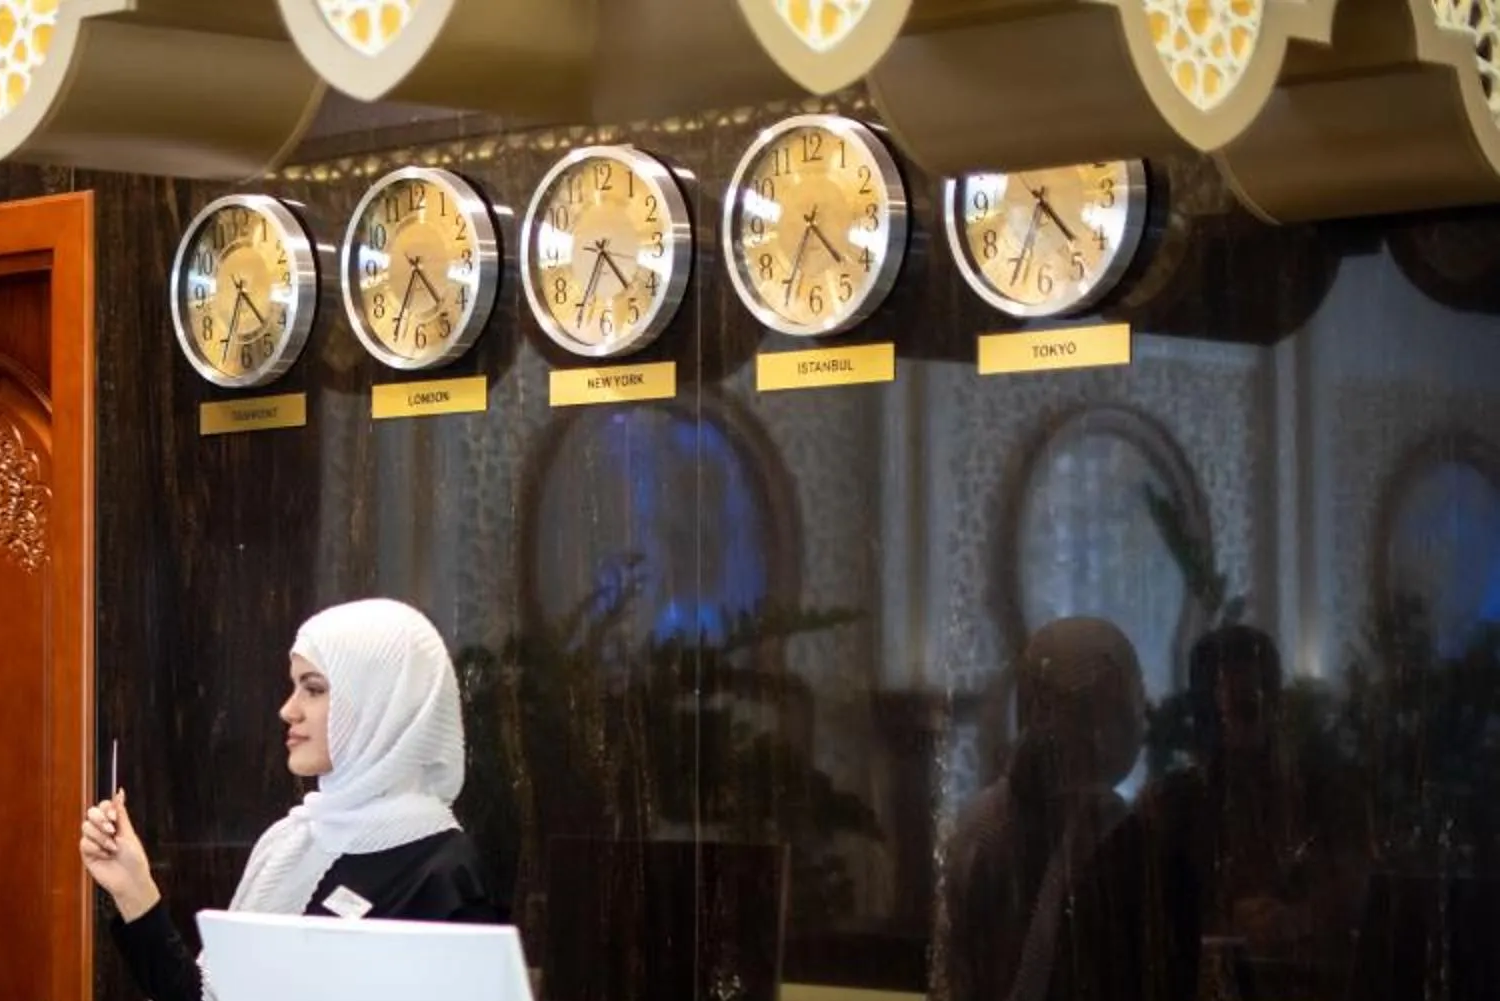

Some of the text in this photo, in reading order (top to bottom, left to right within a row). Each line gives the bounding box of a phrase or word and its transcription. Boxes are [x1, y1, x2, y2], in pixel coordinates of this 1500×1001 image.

[801, 132, 823, 163] 12
[839, 140, 846, 169] 1
[772, 147, 791, 177] 11
[594, 163, 613, 191] 12
[626, 170, 634, 199] 1
[753, 176, 775, 206] 10
[858, 164, 872, 195] 2
[409, 184, 426, 212] 12
[439, 191, 447, 217] 1
[973, 191, 989, 222] 9
[1099, 178, 1116, 210] 3
[384, 198, 400, 224] 11
[549, 205, 569, 233] 10
[645, 195, 658, 223] 2
[865, 203, 879, 233] 3
[261, 217, 268, 242] 1
[455, 214, 467, 241] 2
[750, 215, 765, 245] 9
[1090, 224, 1106, 252] 4
[650, 231, 664, 259] 3
[982, 229, 998, 260] 8
[365, 259, 377, 283] 9
[461, 248, 473, 274] 3
[759, 252, 774, 281] 8
[859, 246, 873, 274] 4
[1007, 257, 1024, 288] 7
[1068, 251, 1085, 283] 5
[555, 276, 568, 305] 8
[645, 269, 658, 298] 4
[781, 279, 792, 308] 7
[837, 273, 853, 304] 5
[1036, 264, 1053, 296] 6
[194, 284, 205, 309] 9
[373, 294, 385, 319] 8
[456, 286, 468, 312] 4
[808, 284, 824, 316] 6
[439, 312, 451, 338] 5
[575, 302, 586, 329] 7
[599, 310, 613, 338] 6
[627, 297, 640, 325] 5
[202, 315, 213, 341] 8
[392, 316, 404, 343] 7
[414, 323, 427, 350] 6
[241, 343, 252, 369] 6
[263, 334, 274, 358] 5
[1031, 341, 1077, 359] TOKYO
[797, 358, 855, 375] ISTANBUL
[587, 373, 644, 389] NEW YORK
[407, 391, 450, 408] LONDON
